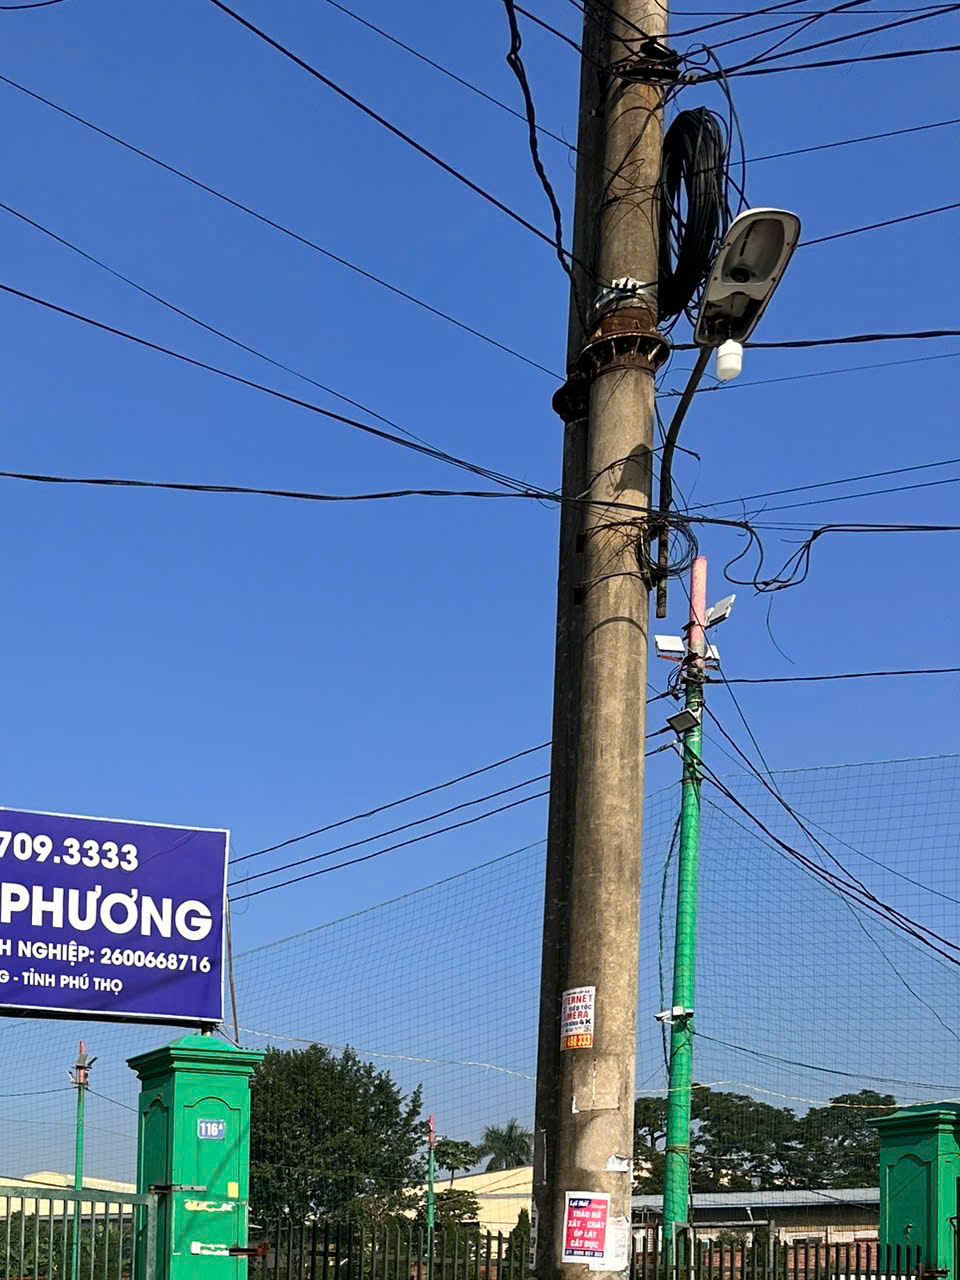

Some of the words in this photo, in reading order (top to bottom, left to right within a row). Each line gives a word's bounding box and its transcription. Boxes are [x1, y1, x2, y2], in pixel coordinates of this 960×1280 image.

[0, 882, 213, 941] PHƯƠNG
[18, 940, 96, 966] NGHIỆP:
[100, 947, 212, 973] 2600668716
[22, 967, 56, 988] TỈNH
[60, 973, 89, 990] PHÚ
[93, 977, 123, 996] THỌ
